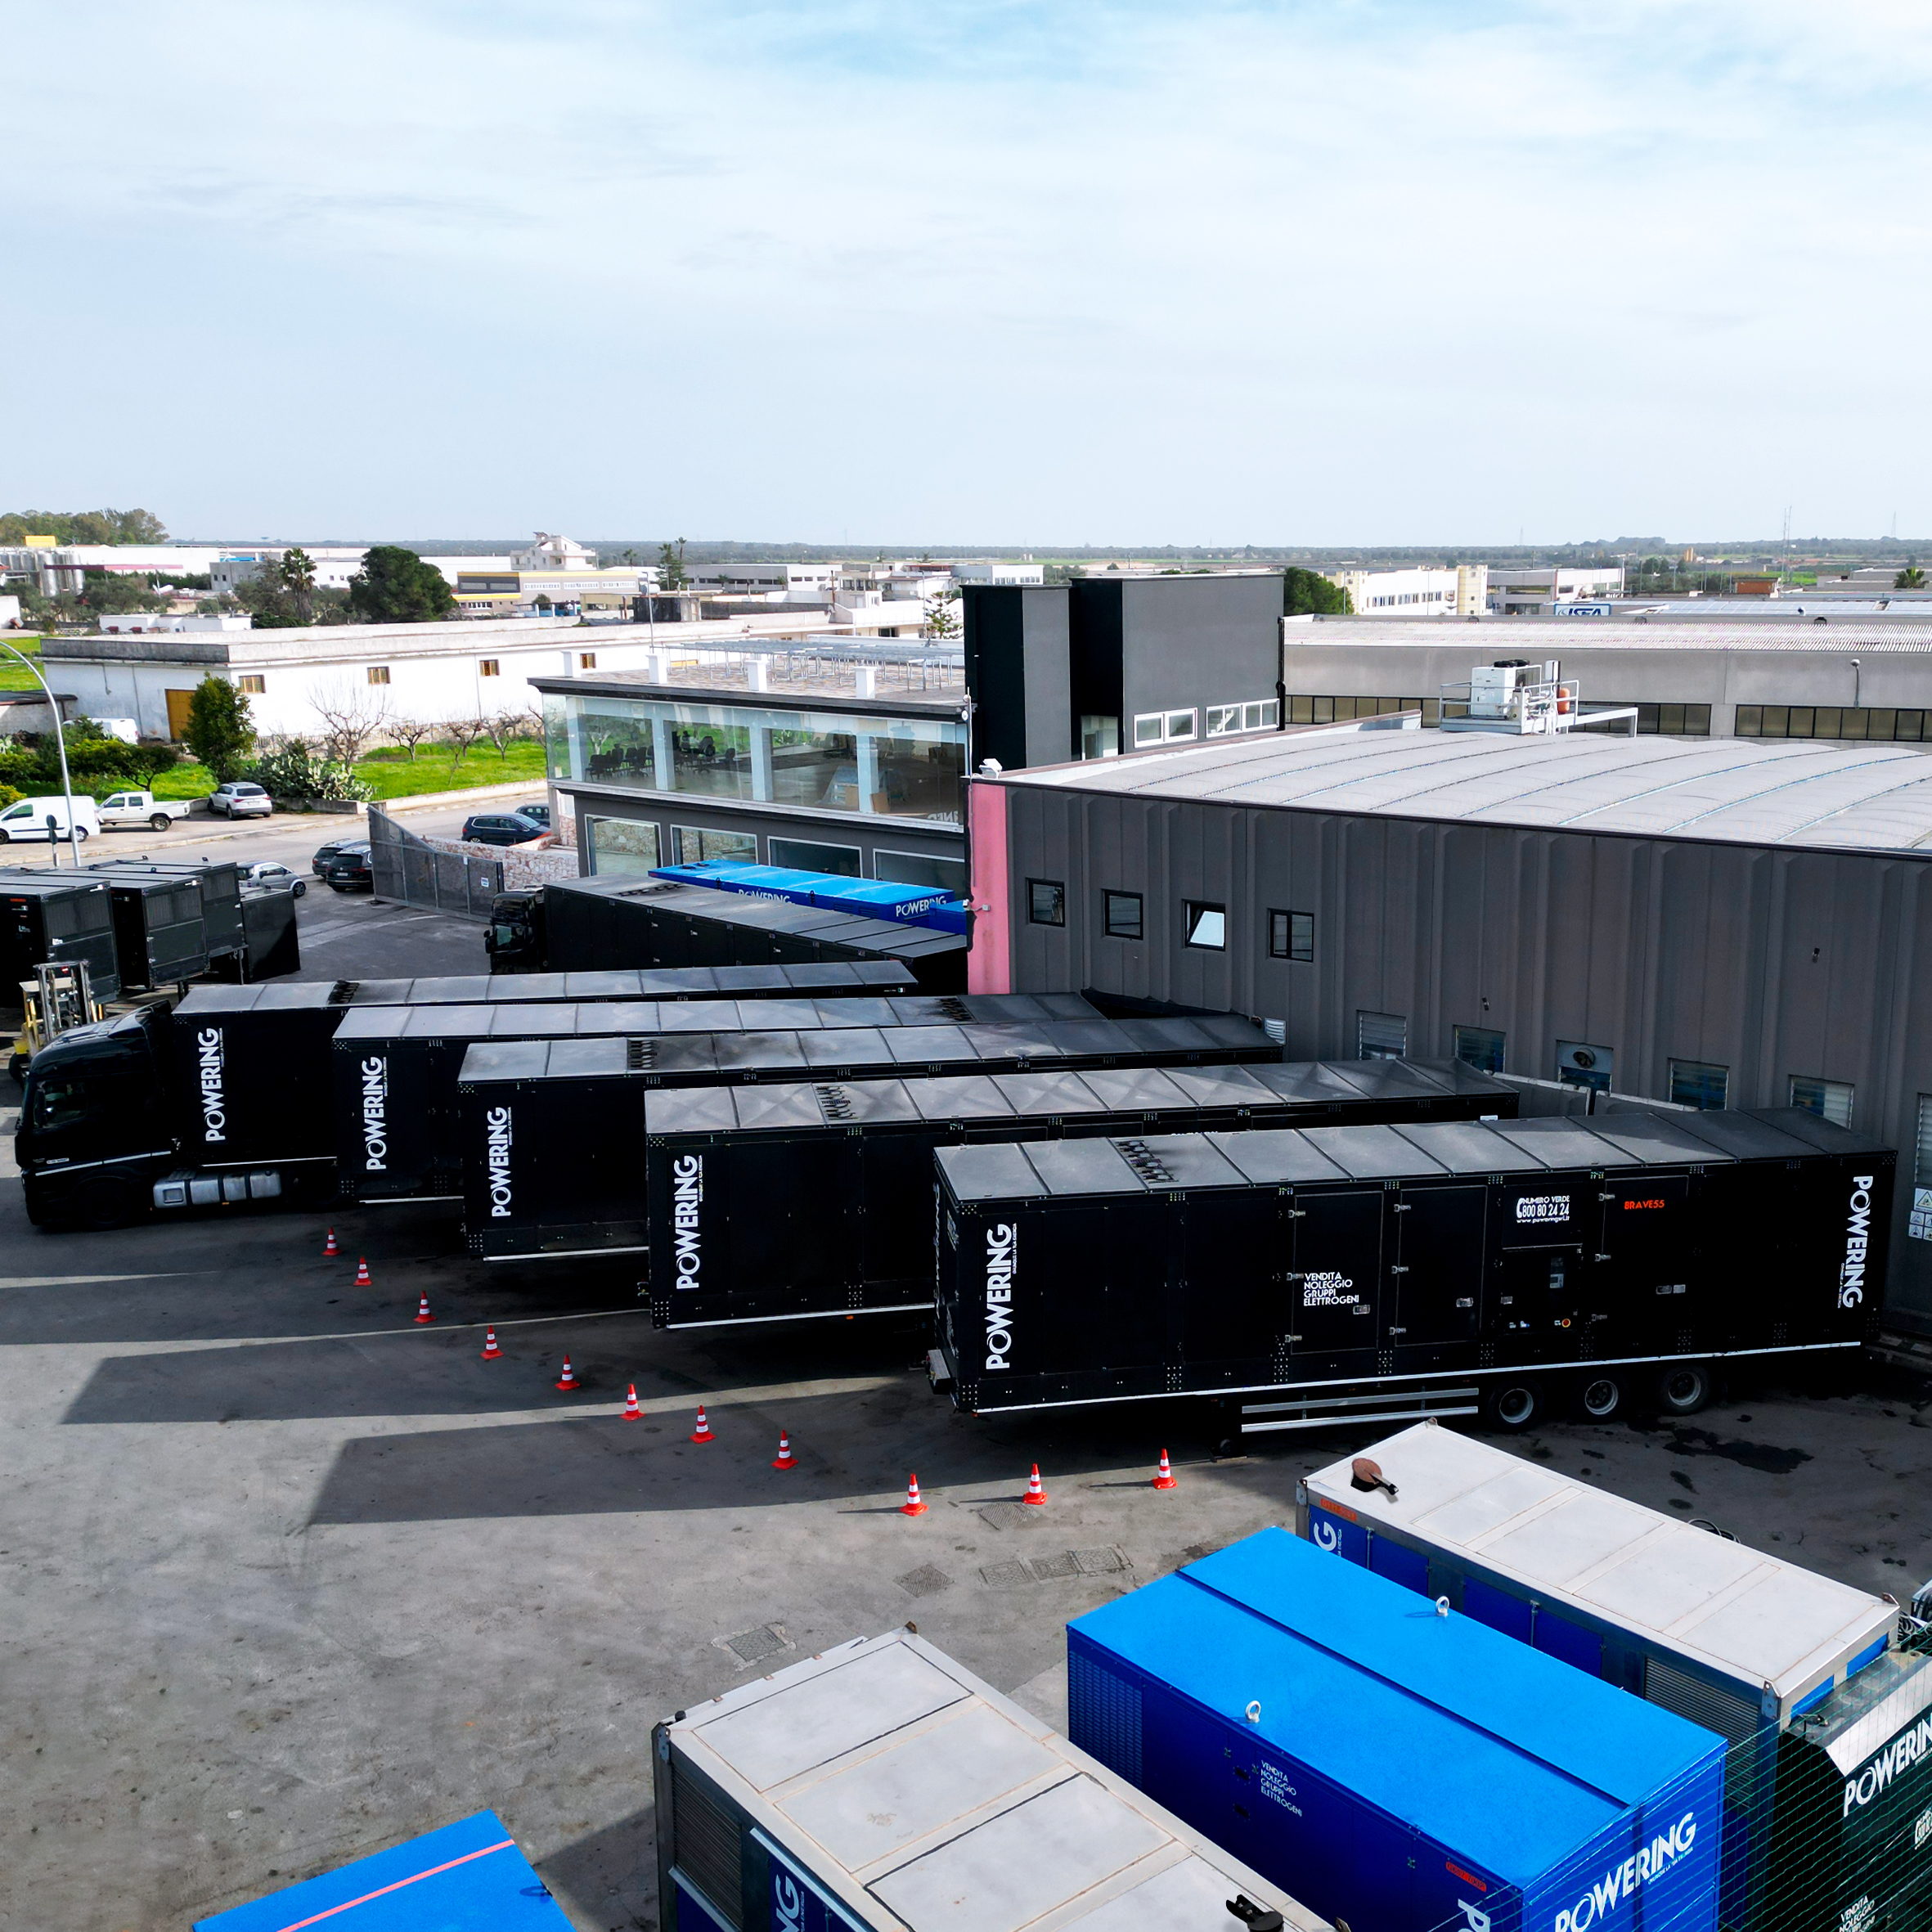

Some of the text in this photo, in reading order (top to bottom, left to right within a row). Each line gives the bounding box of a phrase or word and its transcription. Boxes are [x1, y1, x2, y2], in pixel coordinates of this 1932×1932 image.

[197, 1028, 226, 1142] POWERING
[361, 1057, 387, 1170] POWERING
[487, 1107, 512, 1217] POWERING
[673, 1155, 702, 1290] POWERING
[1522, 1202, 1570, 1217] 800 80 24 24
[1842, 1175, 1874, 1308] POWERING
[1304, 1279, 1353, 1290] NOLEGGIO
[1305, 1272, 1342, 1281] VENDITA
[984, 1224, 1014, 1370] POWERING
[1304, 1288, 1336, 1298] GRUPPI
[1304, 1295, 1359, 1306] ELETTROGENI
[1260, 1759, 1288, 1783] VENDITA
[1260, 1768, 1296, 1795] NOLEGGIO
[1260, 1778, 1284, 1797] GRUPPI
[1260, 1785, 1302, 1817] ELETTROGENI
